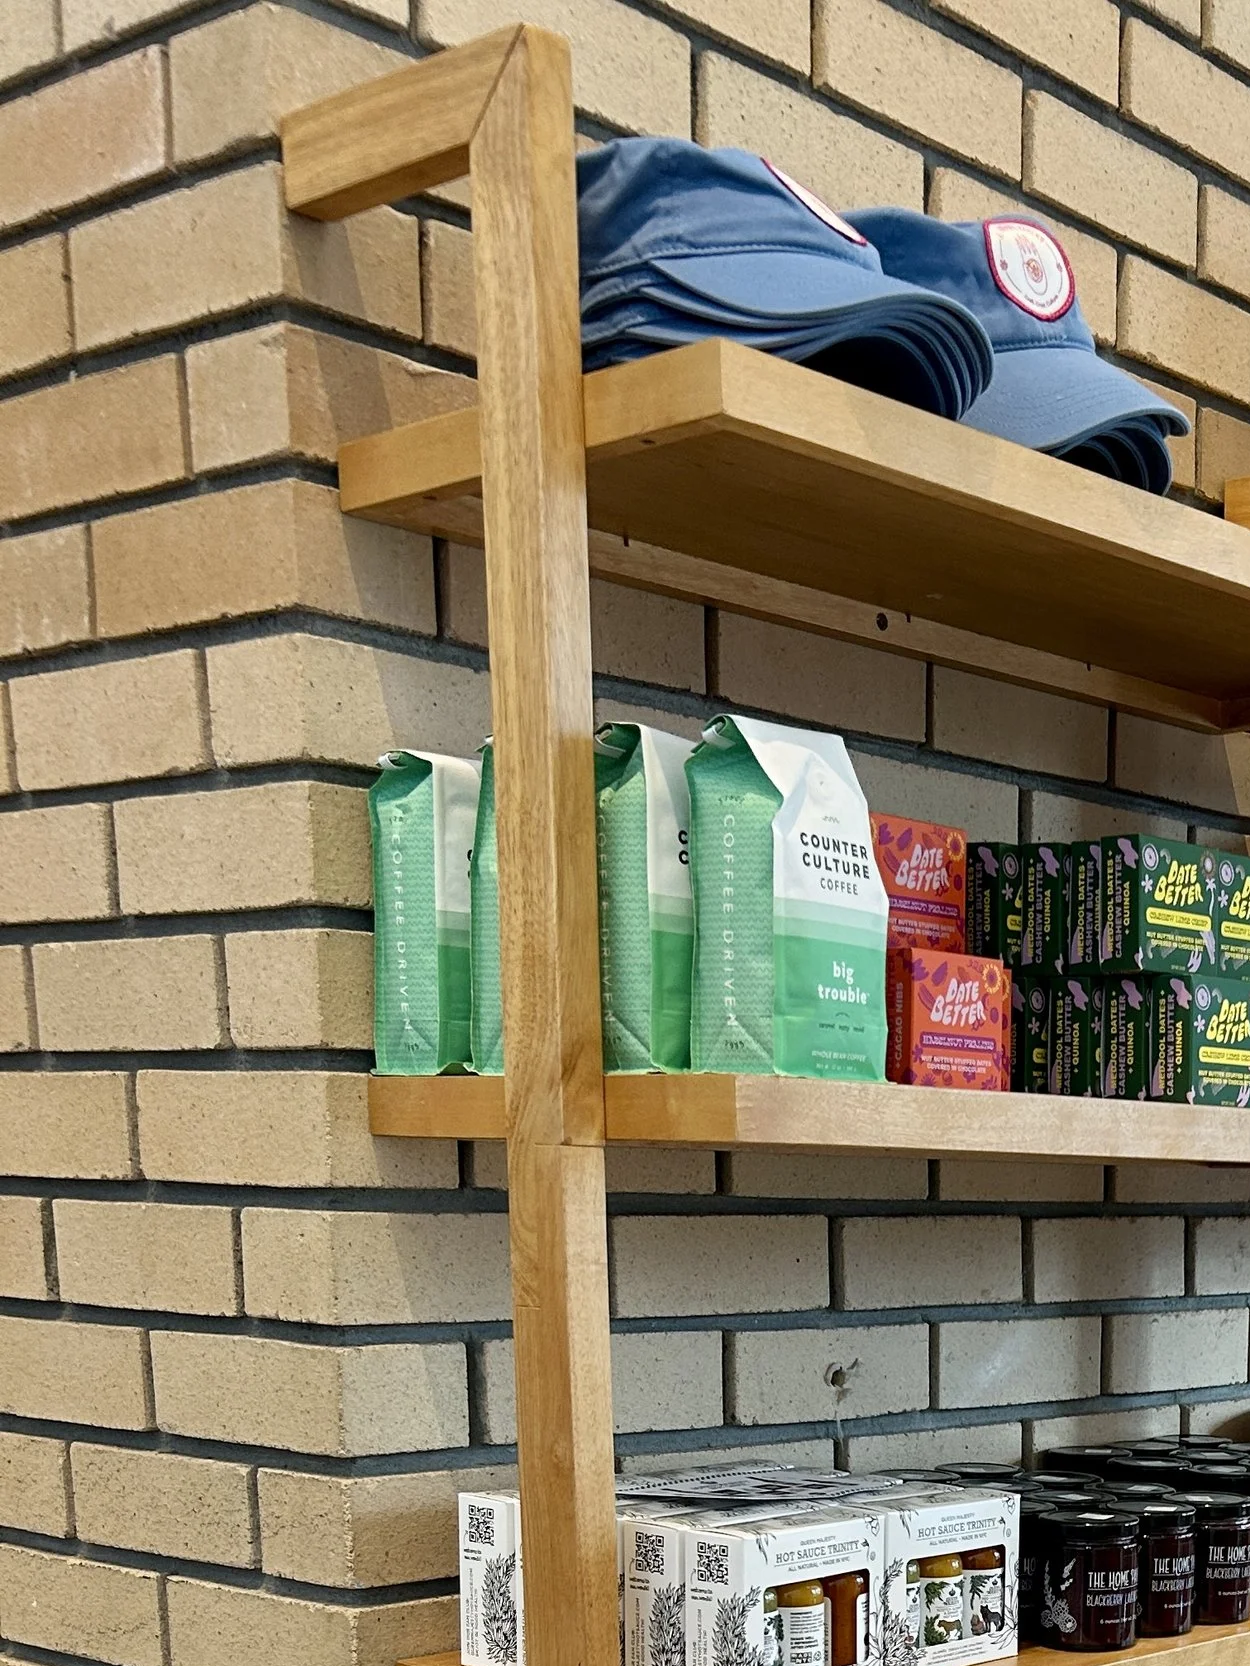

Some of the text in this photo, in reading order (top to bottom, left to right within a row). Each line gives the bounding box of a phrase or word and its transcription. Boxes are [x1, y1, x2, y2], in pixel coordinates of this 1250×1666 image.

[800, 832, 868, 860] COUNTER
[910, 843, 943, 869] DATE
[802, 852, 870, 879] CULTURE
[895, 859, 950, 892] BETTER
[1167, 859, 1198, 886] DATE
[820, 877, 859, 896] COFFEE
[1027, 866, 1035, 902] DATES
[1154, 875, 1203, 907] BETTER
[1035, 861, 1044, 964] CASHEW BUTTER
[1115, 854, 1123, 958] CASHEW BUTTER
[1123, 880, 1131, 927] QUINOA
[392, 834, 413, 1031] COFFEE DRIVEN
[722, 814, 738, 1026] COFFEE DRIVEN
[832, 960, 854, 985] big
[945, 977, 979, 1004] DATE
[930, 995, 987, 1027] BETTER
[1219, 998, 1248, 1023] DATE
[1063, 995, 1072, 1095] CASHEW BUTTER
[1072, 1022, 1080, 1066] QUINOA
[1166, 994, 1175, 1096] CASHEW BUTTER
[1175, 1021, 1183, 1065] QUINOA
[918, 1517, 997, 1538] HOT SAUCE TRINITY
[776, 1540, 860, 1563] HOT SAUCE TRINITY
[1208, 1545, 1247, 1564] THE HOME
[1153, 1556, 1190, 1576] THE HOME
[1206, 1567, 1240, 1579] BLACKBERRY
[1088, 1569, 1130, 1591] THE HOME
[1151, 1579, 1185, 1592] BLACKBERRY
[1086, 1594, 1124, 1607] BLACKBERRY
